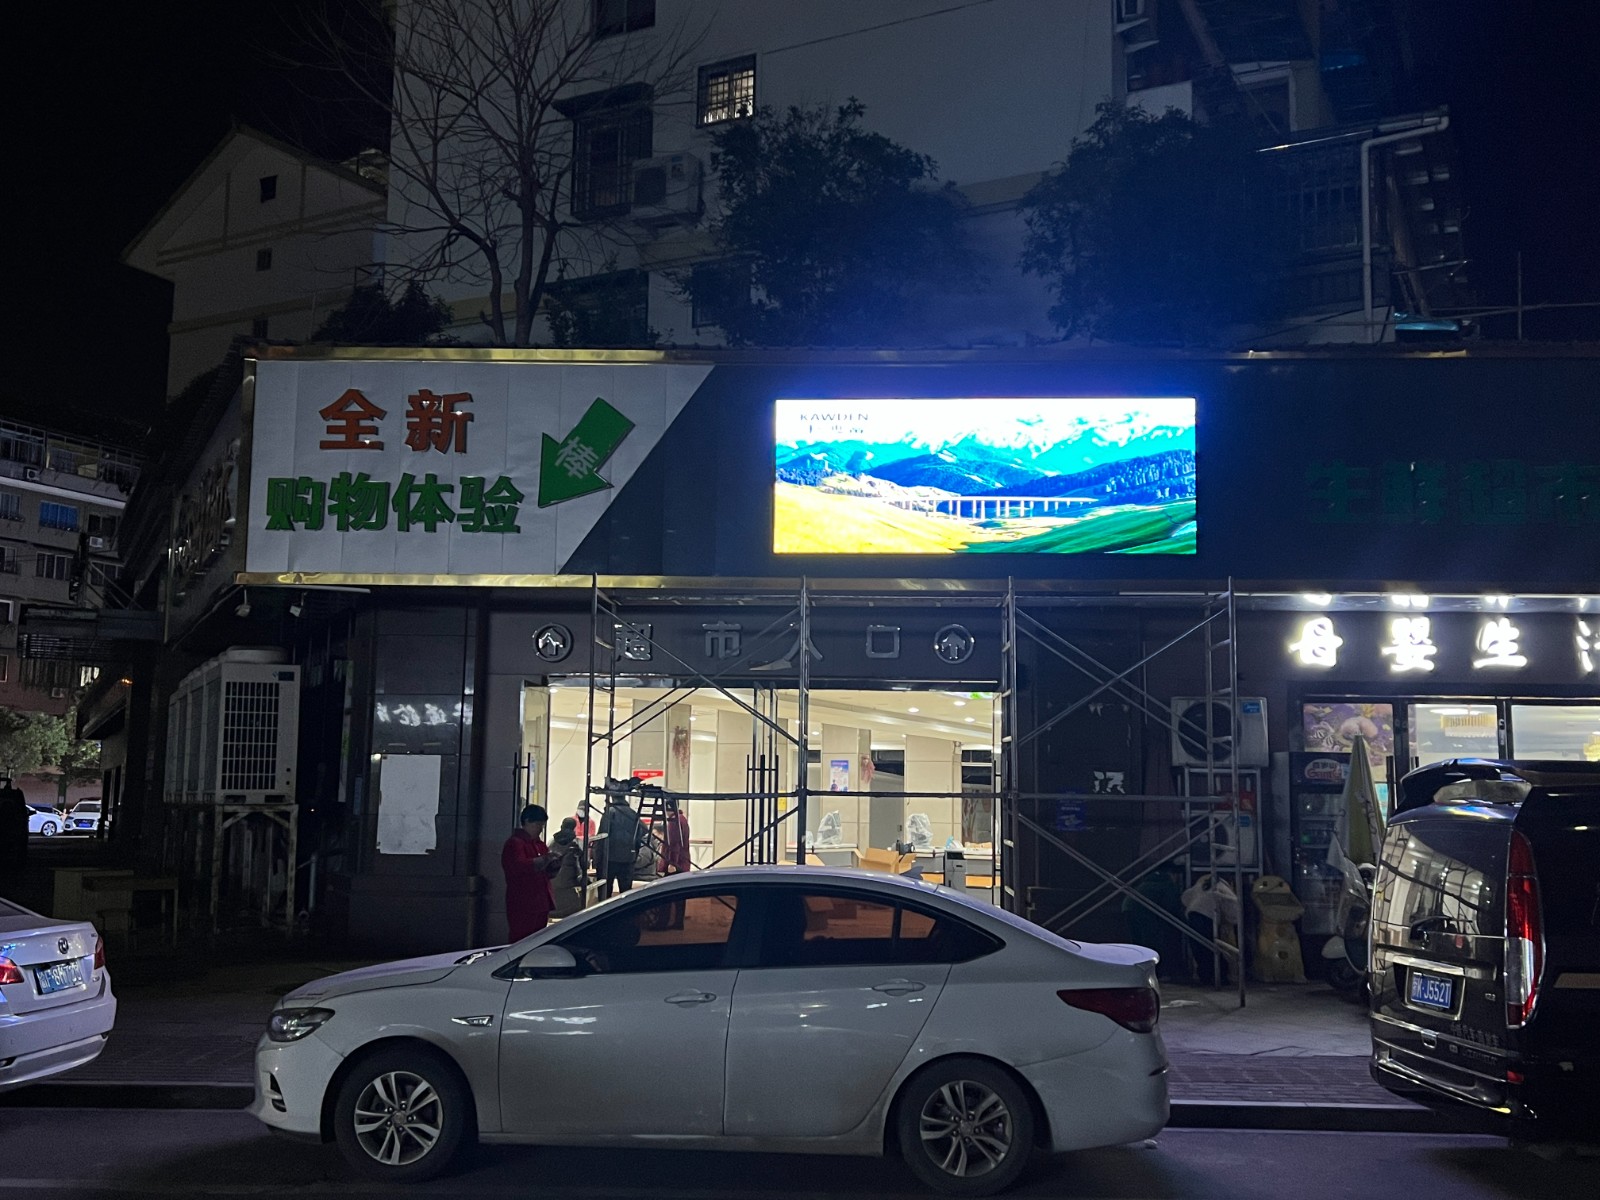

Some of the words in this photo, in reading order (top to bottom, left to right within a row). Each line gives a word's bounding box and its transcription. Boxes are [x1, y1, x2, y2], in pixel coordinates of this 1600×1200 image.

[319, 389, 474, 453] 全新
[555, 436, 599, 480] 棒
[266, 472, 524, 533] 购物体验
